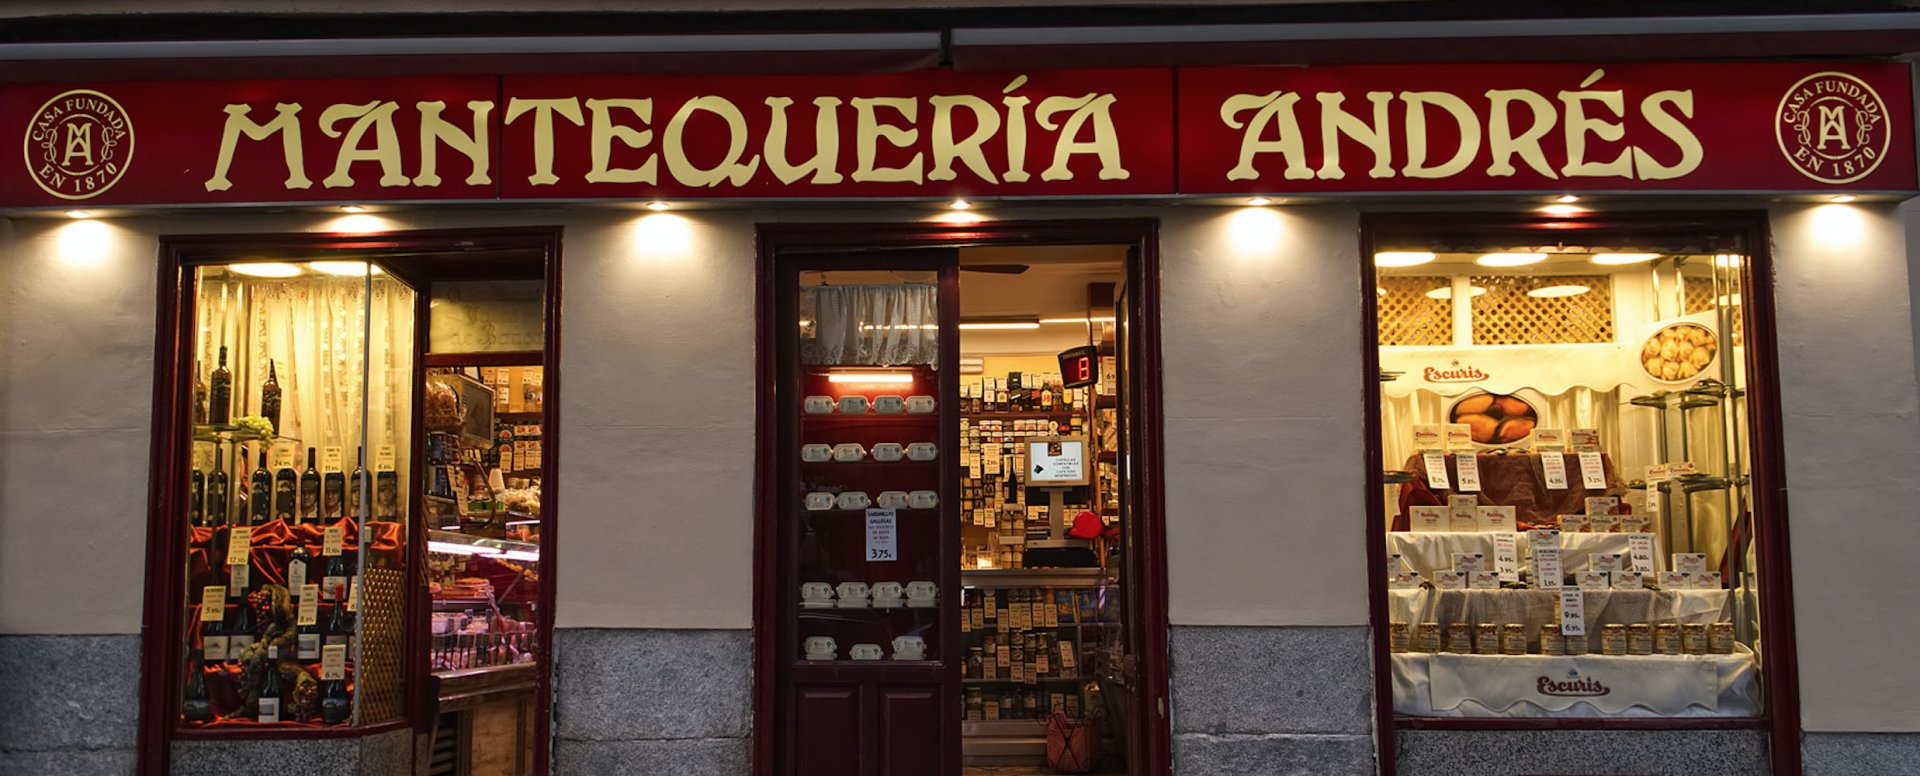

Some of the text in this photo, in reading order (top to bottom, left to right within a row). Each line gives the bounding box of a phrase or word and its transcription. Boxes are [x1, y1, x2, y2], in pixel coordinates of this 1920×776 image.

[1783, 80, 1881, 124] CASA FUNDADA
[32, 98, 126, 141] CASA FUNDADA
[205, 75, 1129, 191] MANTEQUERÍA
[1220, 68, 1704, 181] ANDRÉS
[1794, 146, 1876, 176] EN 1870
[38, 162, 117, 192] EN 1870
[1078, 356, 1090, 381] 8
[1423, 365, 1490, 383] Escuris
[1536, 676, 1611, 697] Escuris
